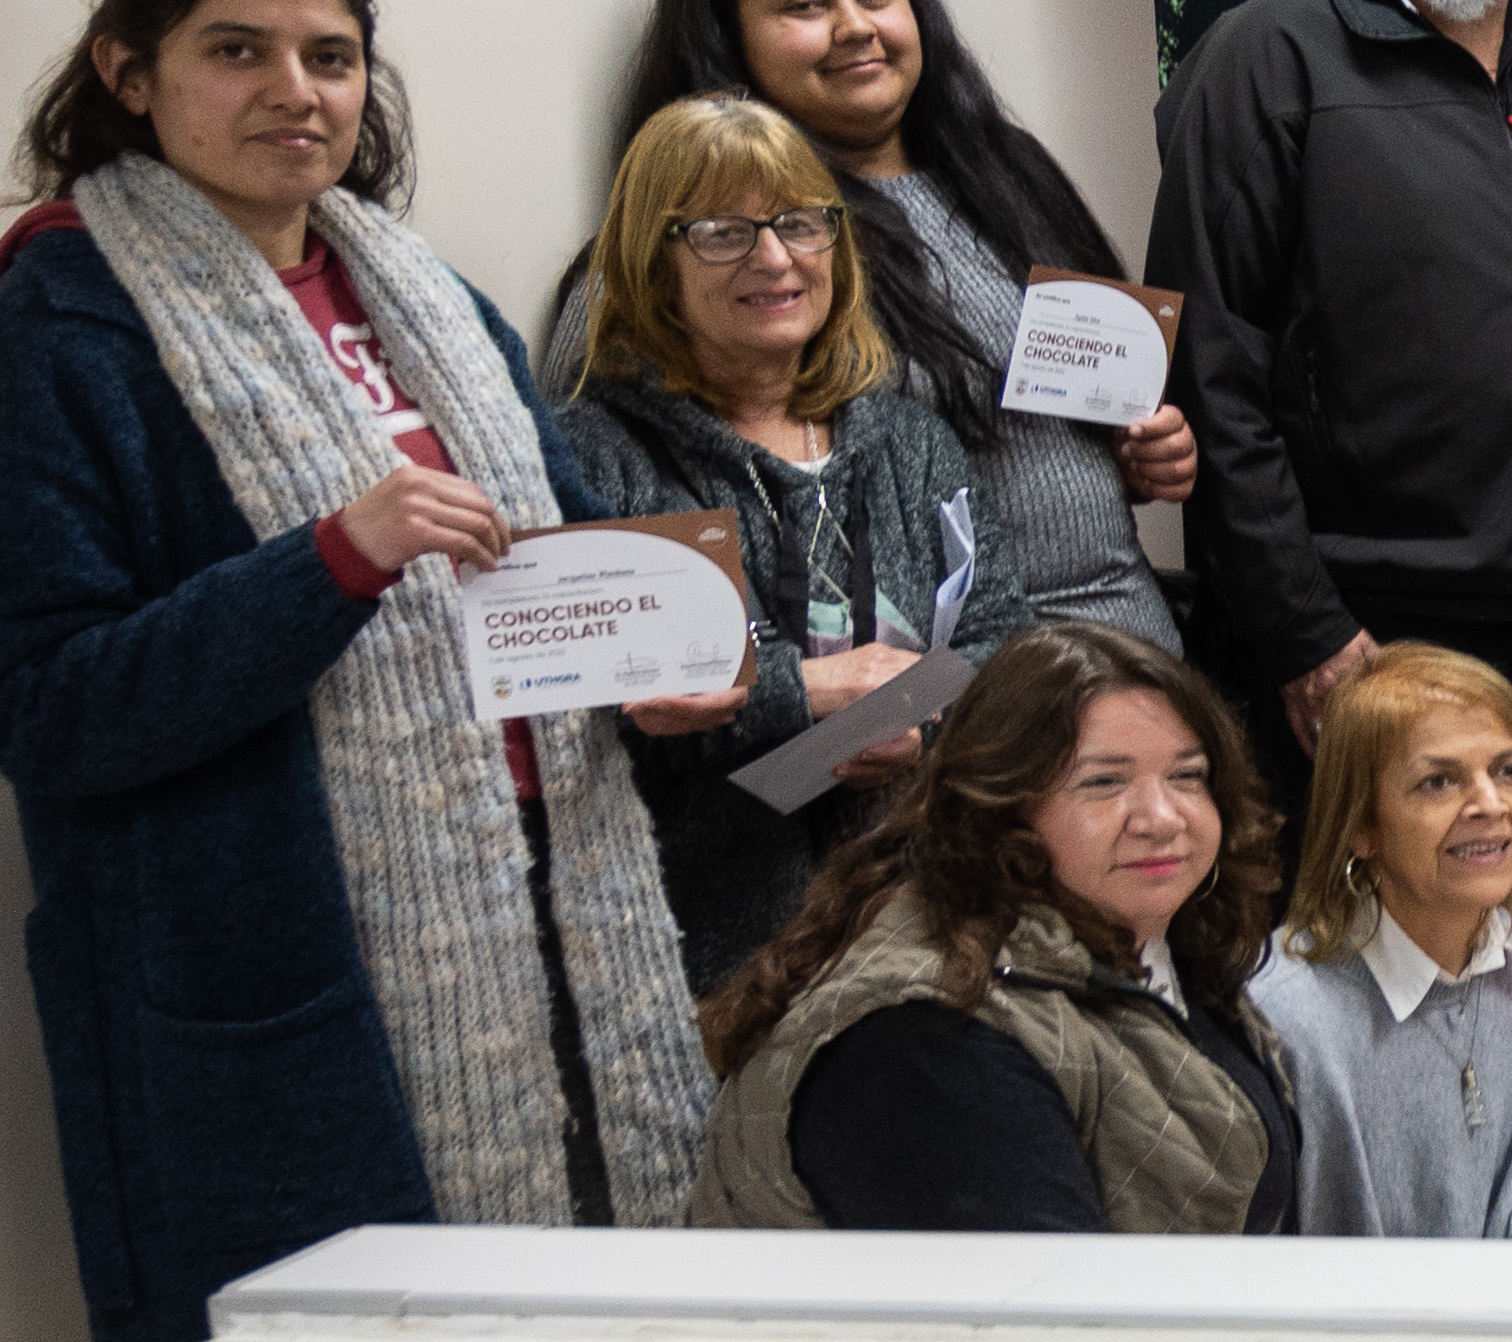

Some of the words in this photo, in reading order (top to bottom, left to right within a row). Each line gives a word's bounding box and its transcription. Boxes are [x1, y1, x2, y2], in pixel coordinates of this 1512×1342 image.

[1024, 346, 1100, 369] CHOCOLATE
[1028, 329, 1113, 355] CONOCIENDO
[1115, 344, 1128, 358] EL
[485, 597, 632, 629] CONOCIENDO
[639, 594, 662, 611] EL
[487, 620, 619, 650] CHOCOLATE
